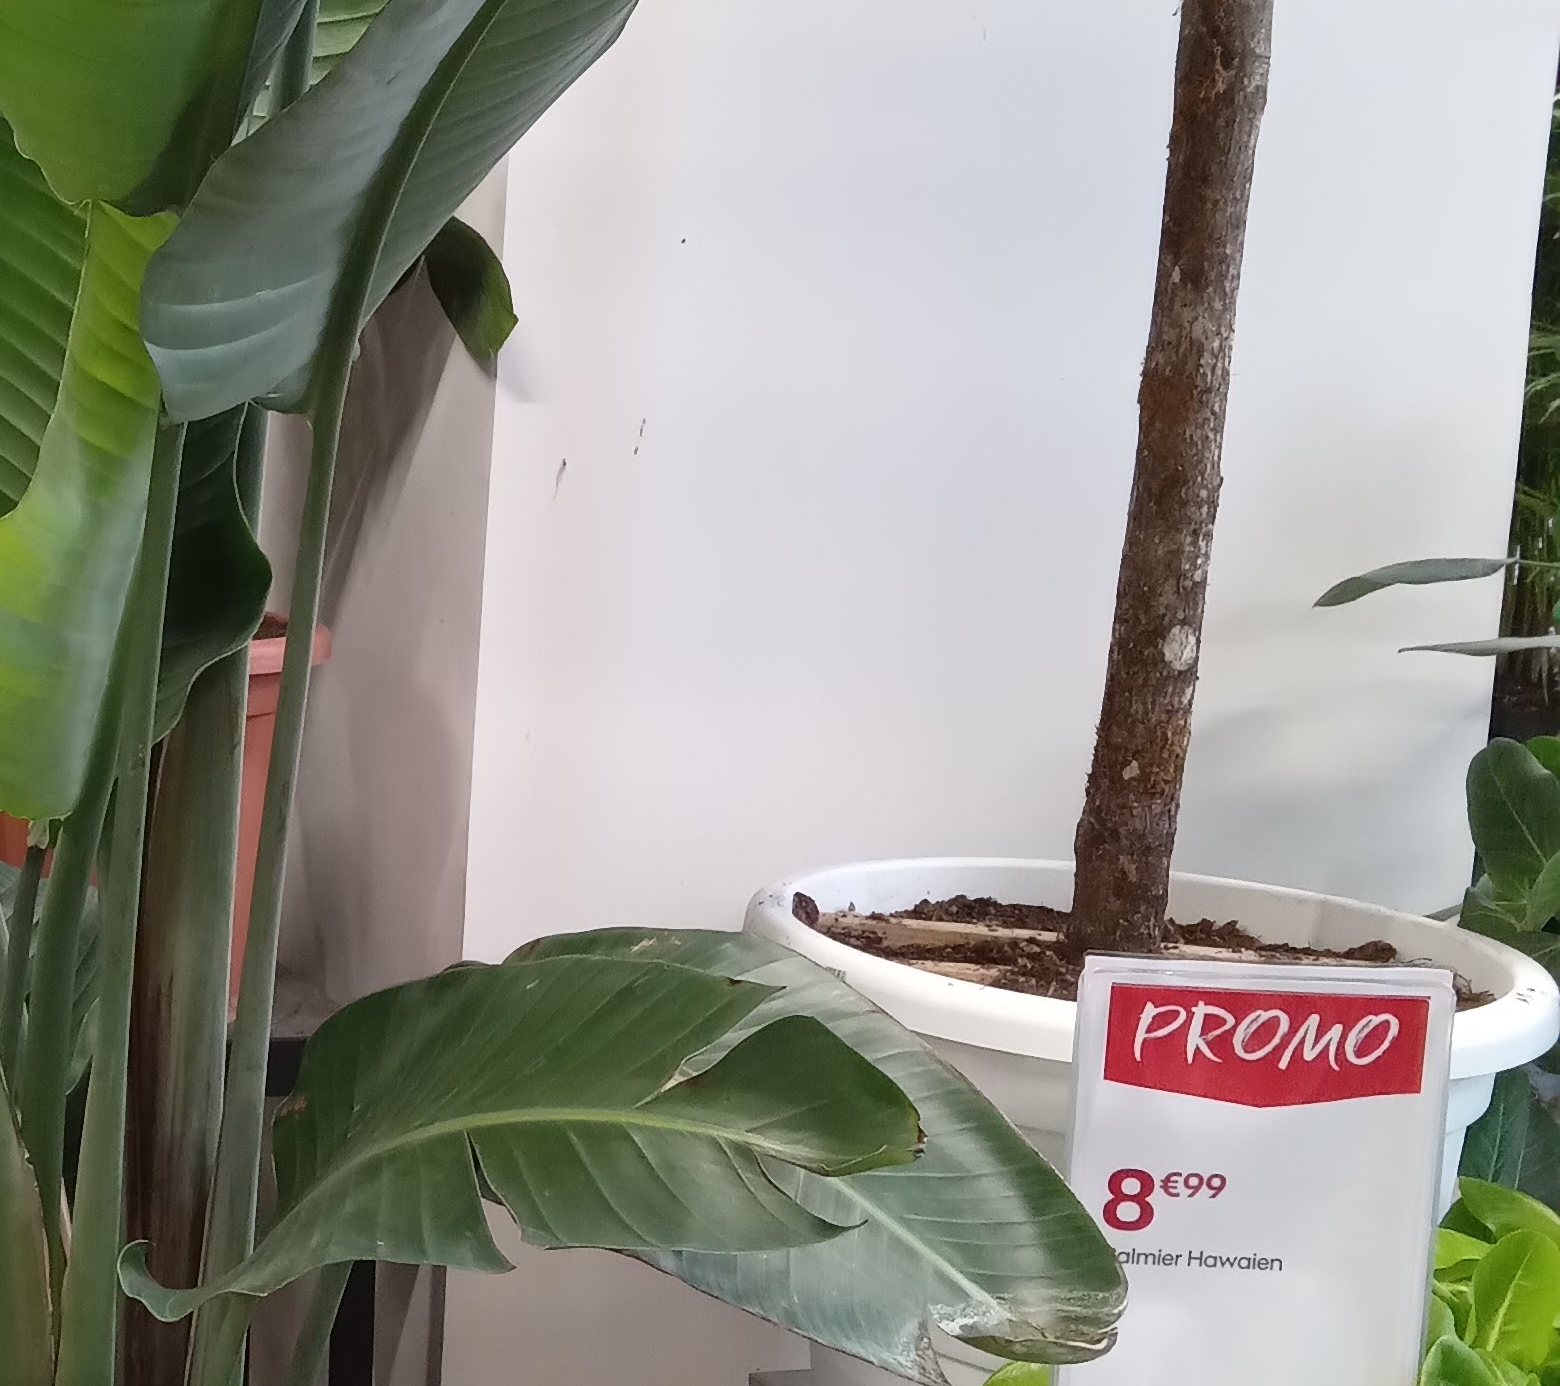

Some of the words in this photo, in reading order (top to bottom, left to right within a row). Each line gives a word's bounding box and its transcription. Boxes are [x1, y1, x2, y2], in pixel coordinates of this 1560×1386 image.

[1133, 999, 1401, 1071] PROMO
[1114, 1247, 1183, 1268] almier
[1187, 1250, 1284, 1273] Hawaien
